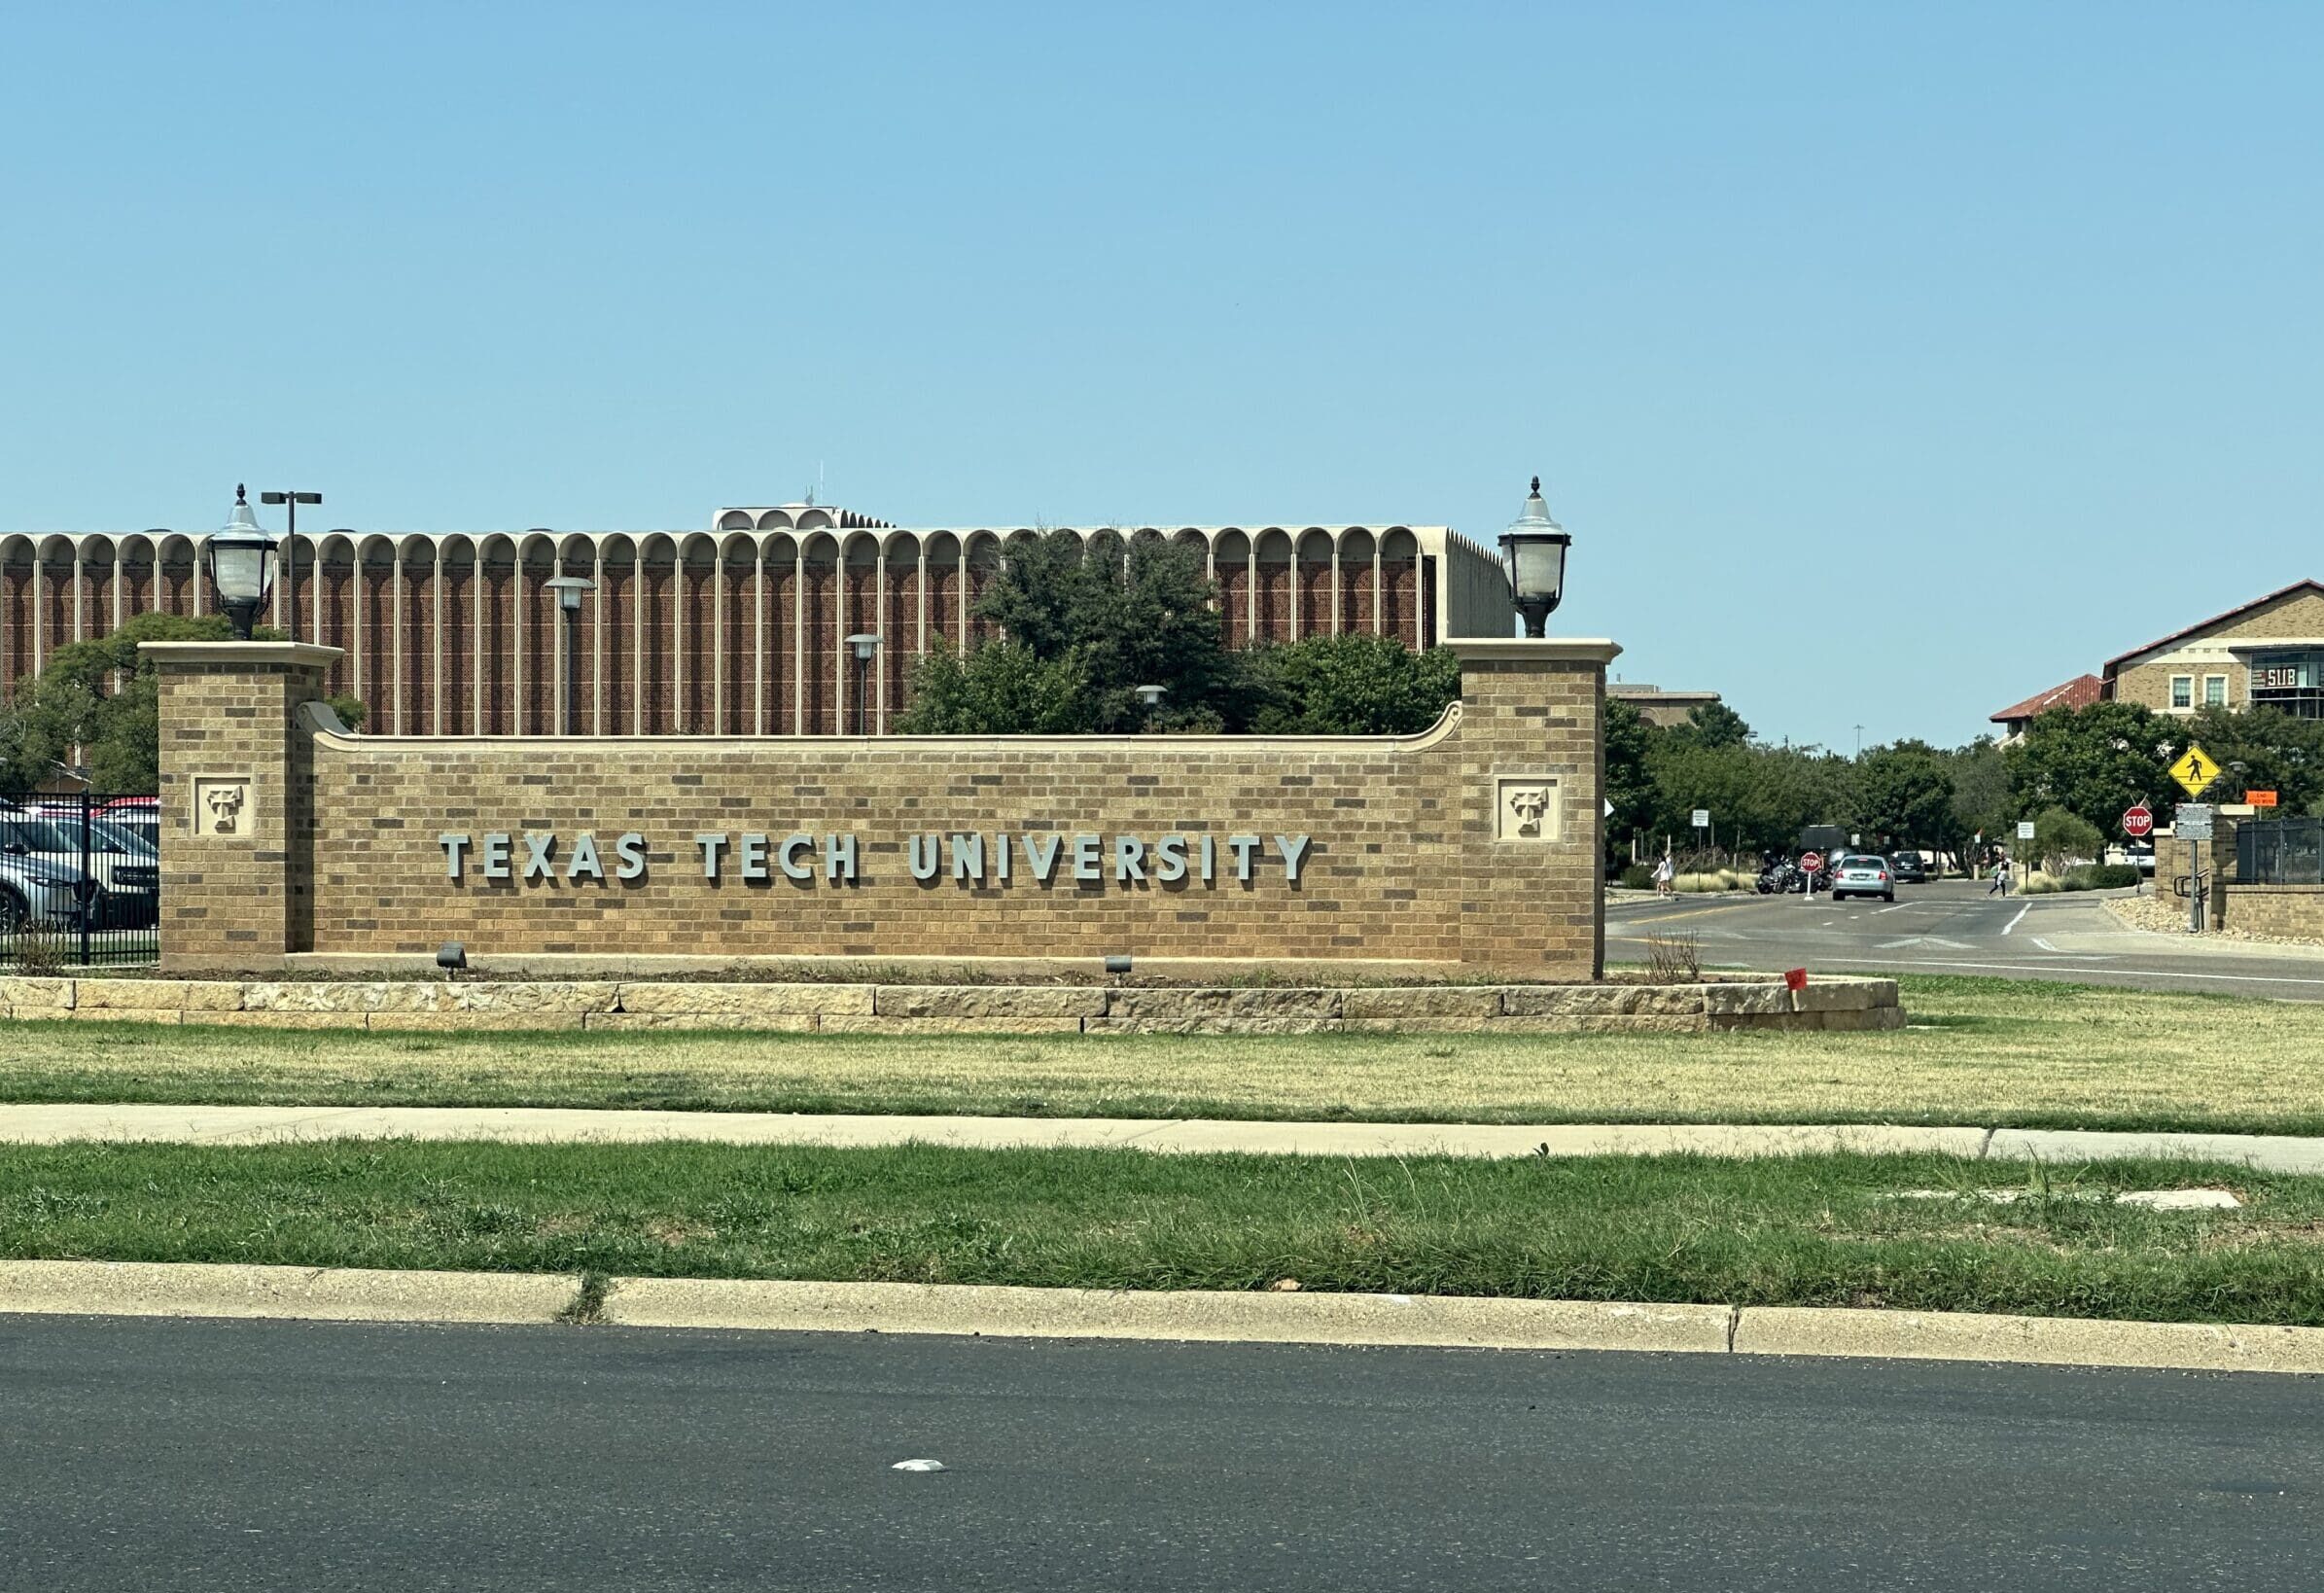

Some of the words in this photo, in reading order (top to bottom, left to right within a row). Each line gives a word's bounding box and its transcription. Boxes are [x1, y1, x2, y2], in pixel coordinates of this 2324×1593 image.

[2268, 668, 2296, 687] SUB
[2126, 815, 2150, 827] STOP
[439, 832, 646, 879] TEXAS
[695, 833, 857, 879] TECH
[908, 834, 1311, 881] UNIVERSITY
